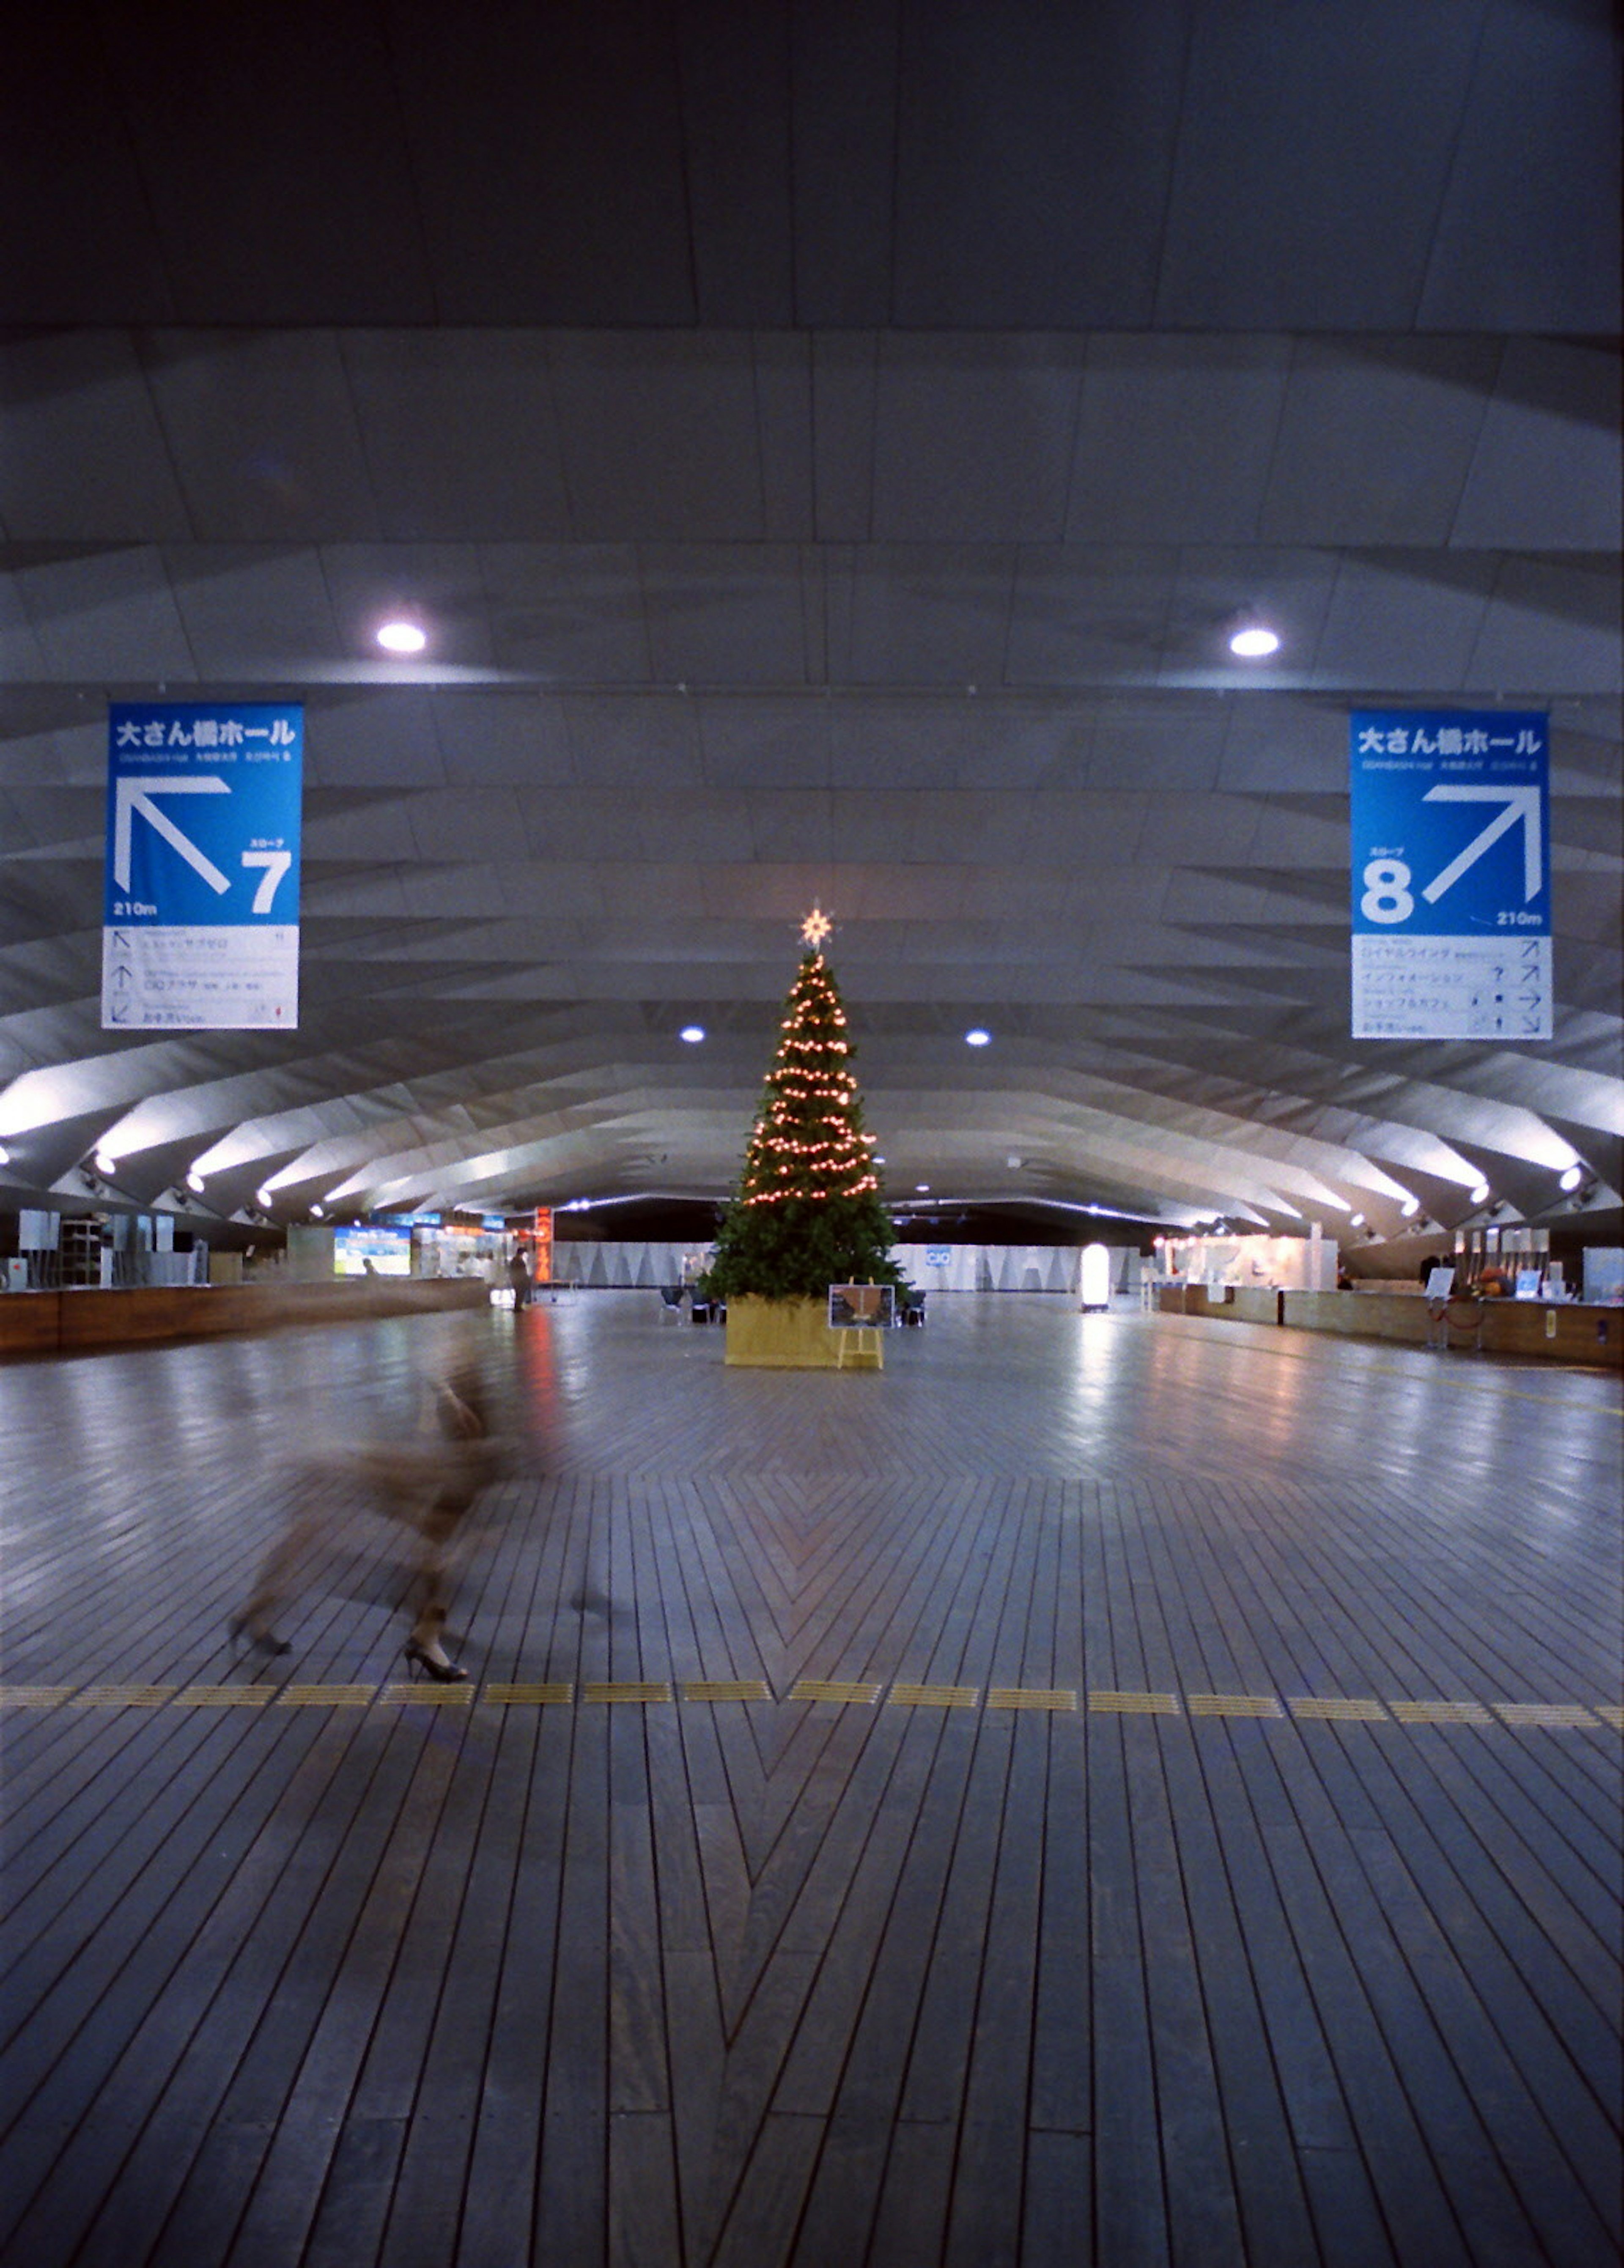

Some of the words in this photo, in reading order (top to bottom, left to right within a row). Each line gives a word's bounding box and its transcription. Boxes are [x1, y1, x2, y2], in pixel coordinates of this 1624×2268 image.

[242, 851, 291, 913] 7
[1361, 858, 1414, 924] 8
[113, 902, 157, 915] 210m
[1497, 911, 1542, 925] 210m
